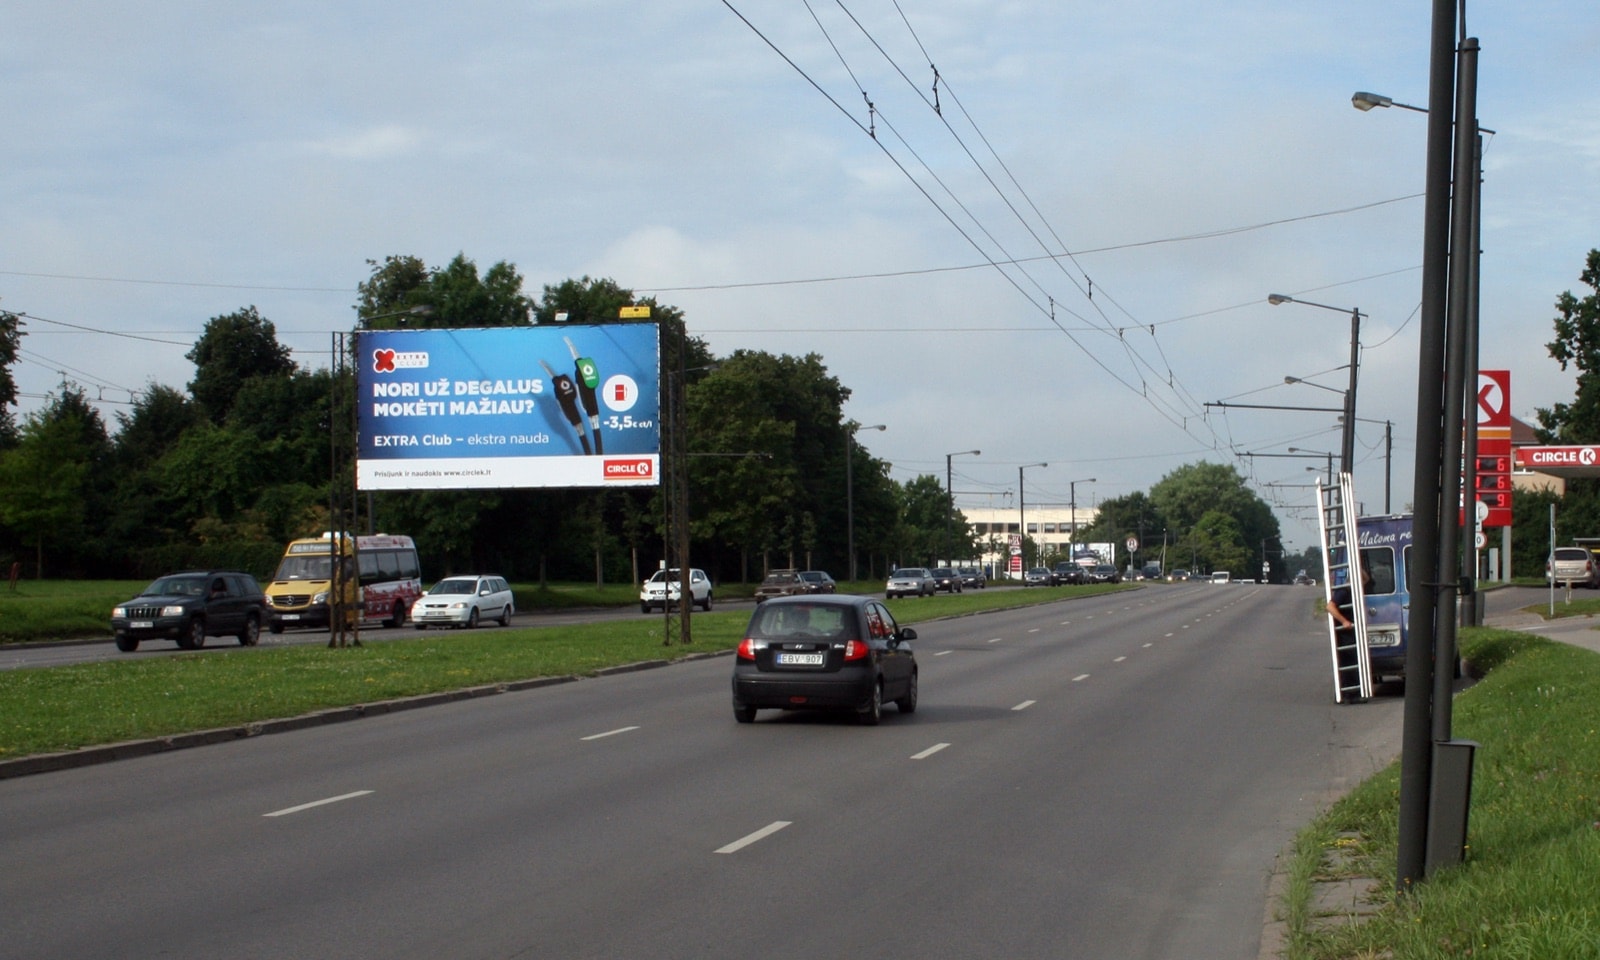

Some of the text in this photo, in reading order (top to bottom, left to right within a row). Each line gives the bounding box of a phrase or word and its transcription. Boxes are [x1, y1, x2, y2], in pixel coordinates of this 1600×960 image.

[373, 378, 543, 397] NORI UŽ DEGALUS
[373, 397, 535, 417] MOKĖTI MAŽIAU?
[374, 435, 419, 447] EXTRA
[422, 434, 452, 446] Club
[467, 433, 506, 445] ekstra
[510, 432, 549, 444] nauda
[1532, 451, 1577, 462] CIRCLE
[444, 469, 492, 477] www.circlek.lt
[606, 464, 636, 473] CIRCLE
[782, 655, 822, 663] EBV 907
